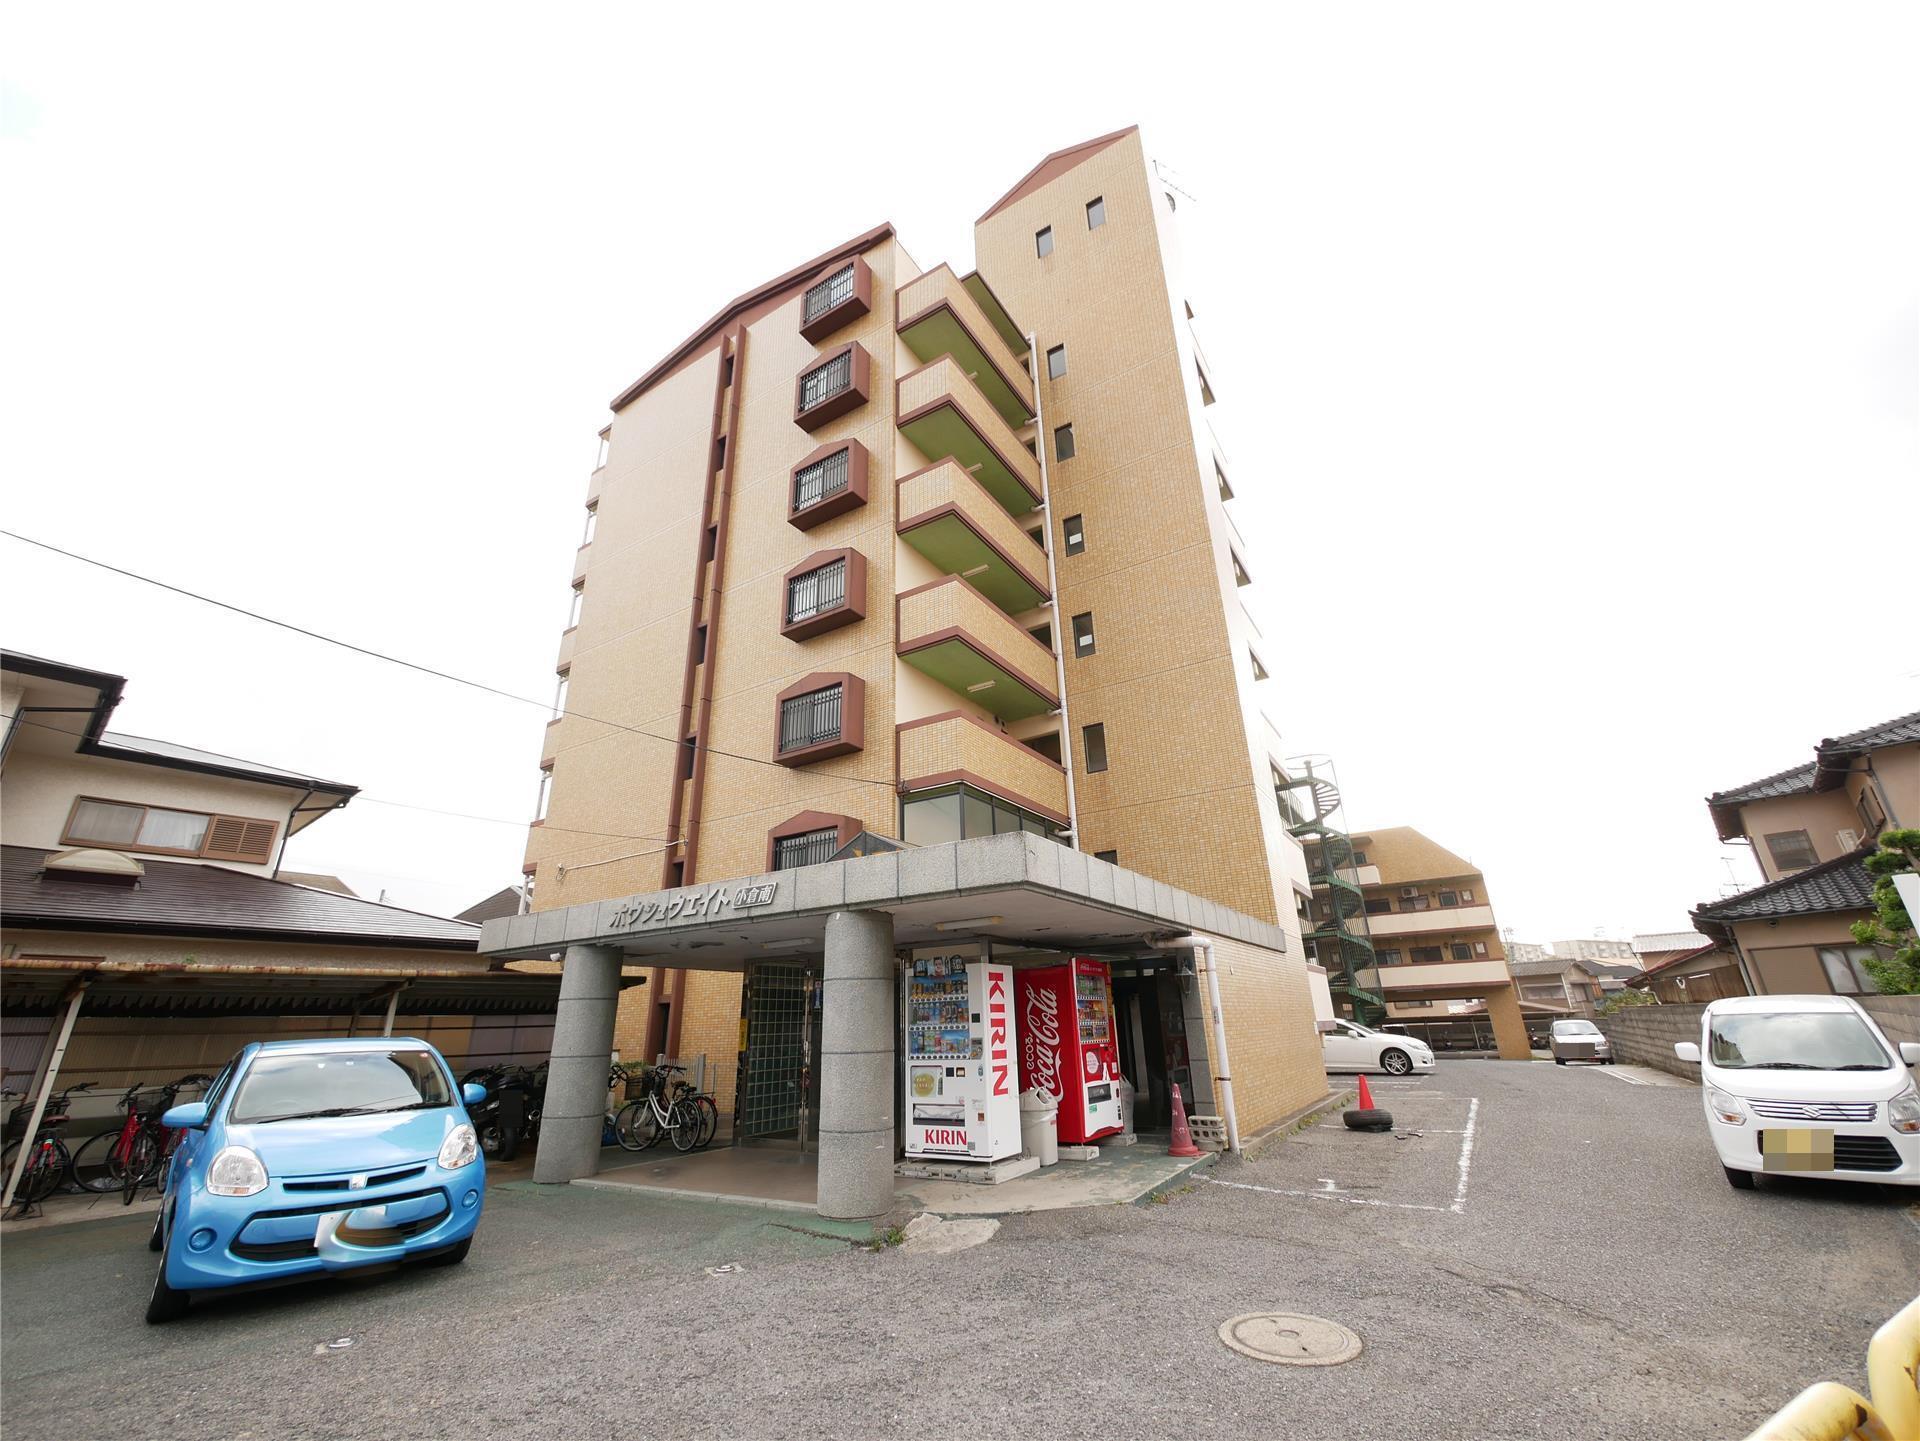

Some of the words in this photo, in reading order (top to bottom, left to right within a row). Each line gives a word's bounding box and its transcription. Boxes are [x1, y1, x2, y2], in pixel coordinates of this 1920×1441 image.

[735, 886, 773, 905] 小倉南
[988, 971, 1009, 1096] KIRIN
[925, 1129, 967, 1145] KIRIN
